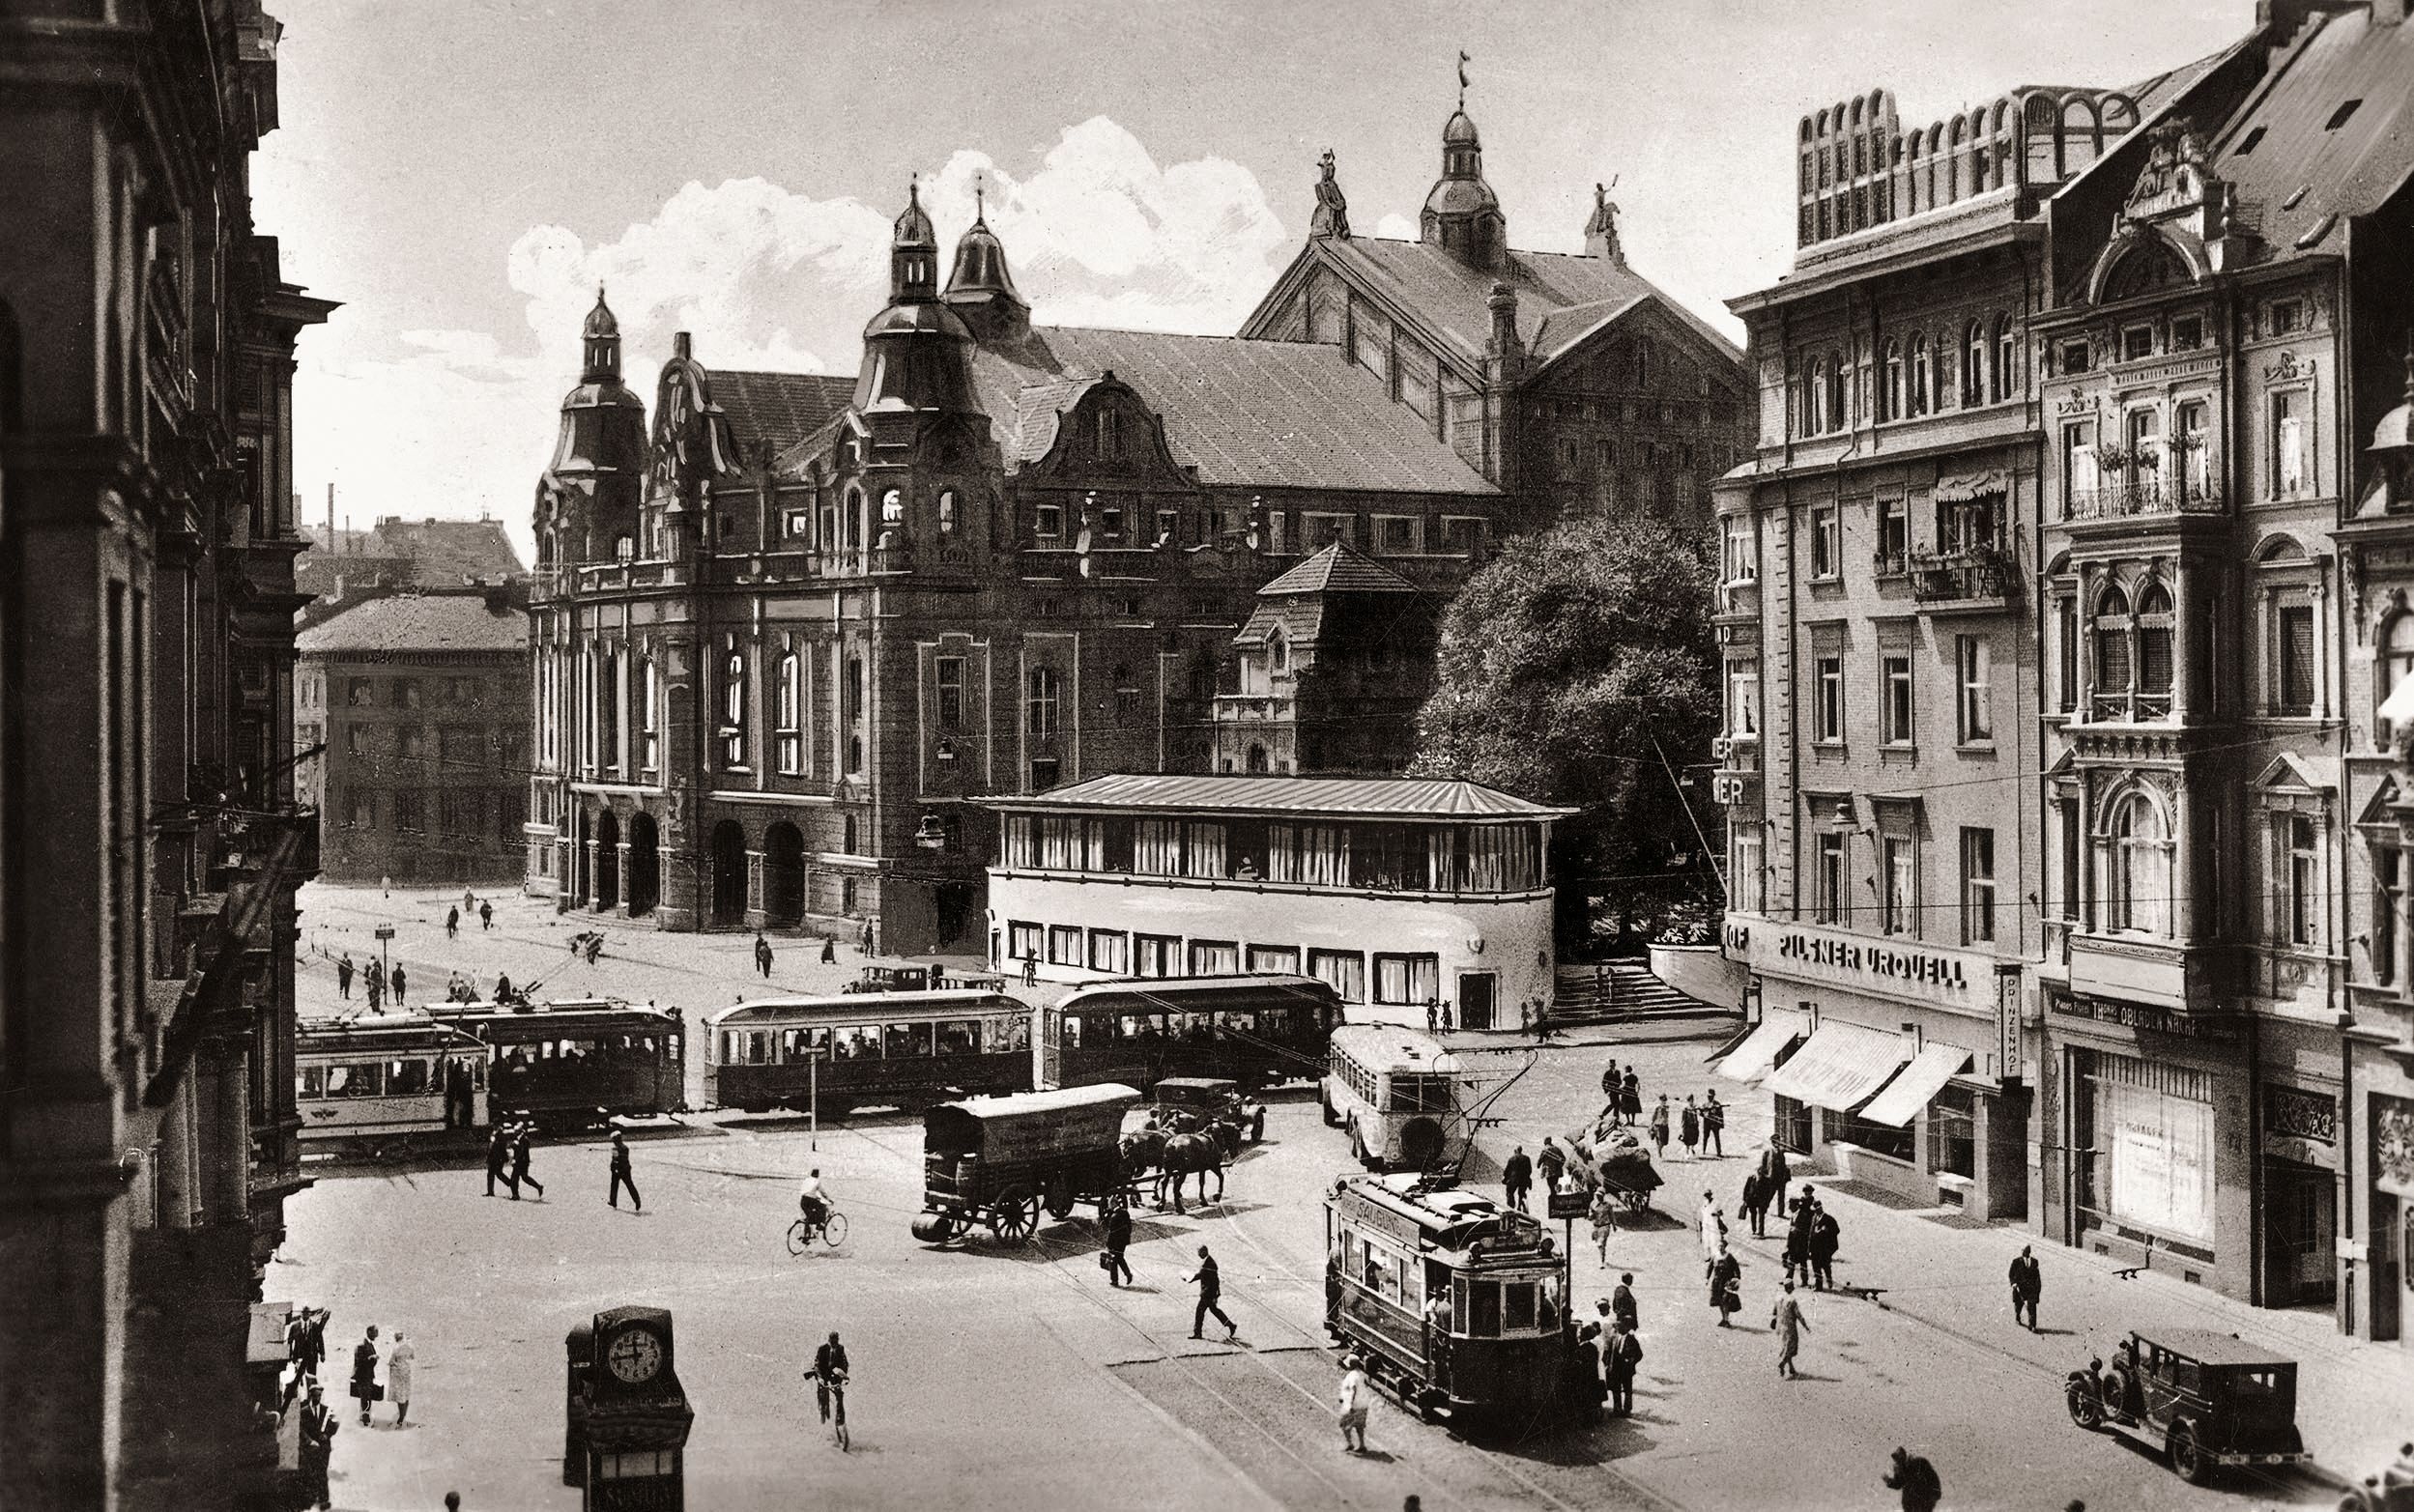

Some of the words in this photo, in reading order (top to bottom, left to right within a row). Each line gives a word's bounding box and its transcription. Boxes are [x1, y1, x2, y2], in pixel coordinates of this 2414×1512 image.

[1724, 924, 1750, 951] OF
[1779, 934, 1861, 971] PILSNER
[1867, 947, 1968, 990] URQUELL
[2007, 979, 2017, 1073] PRINZENHOF
